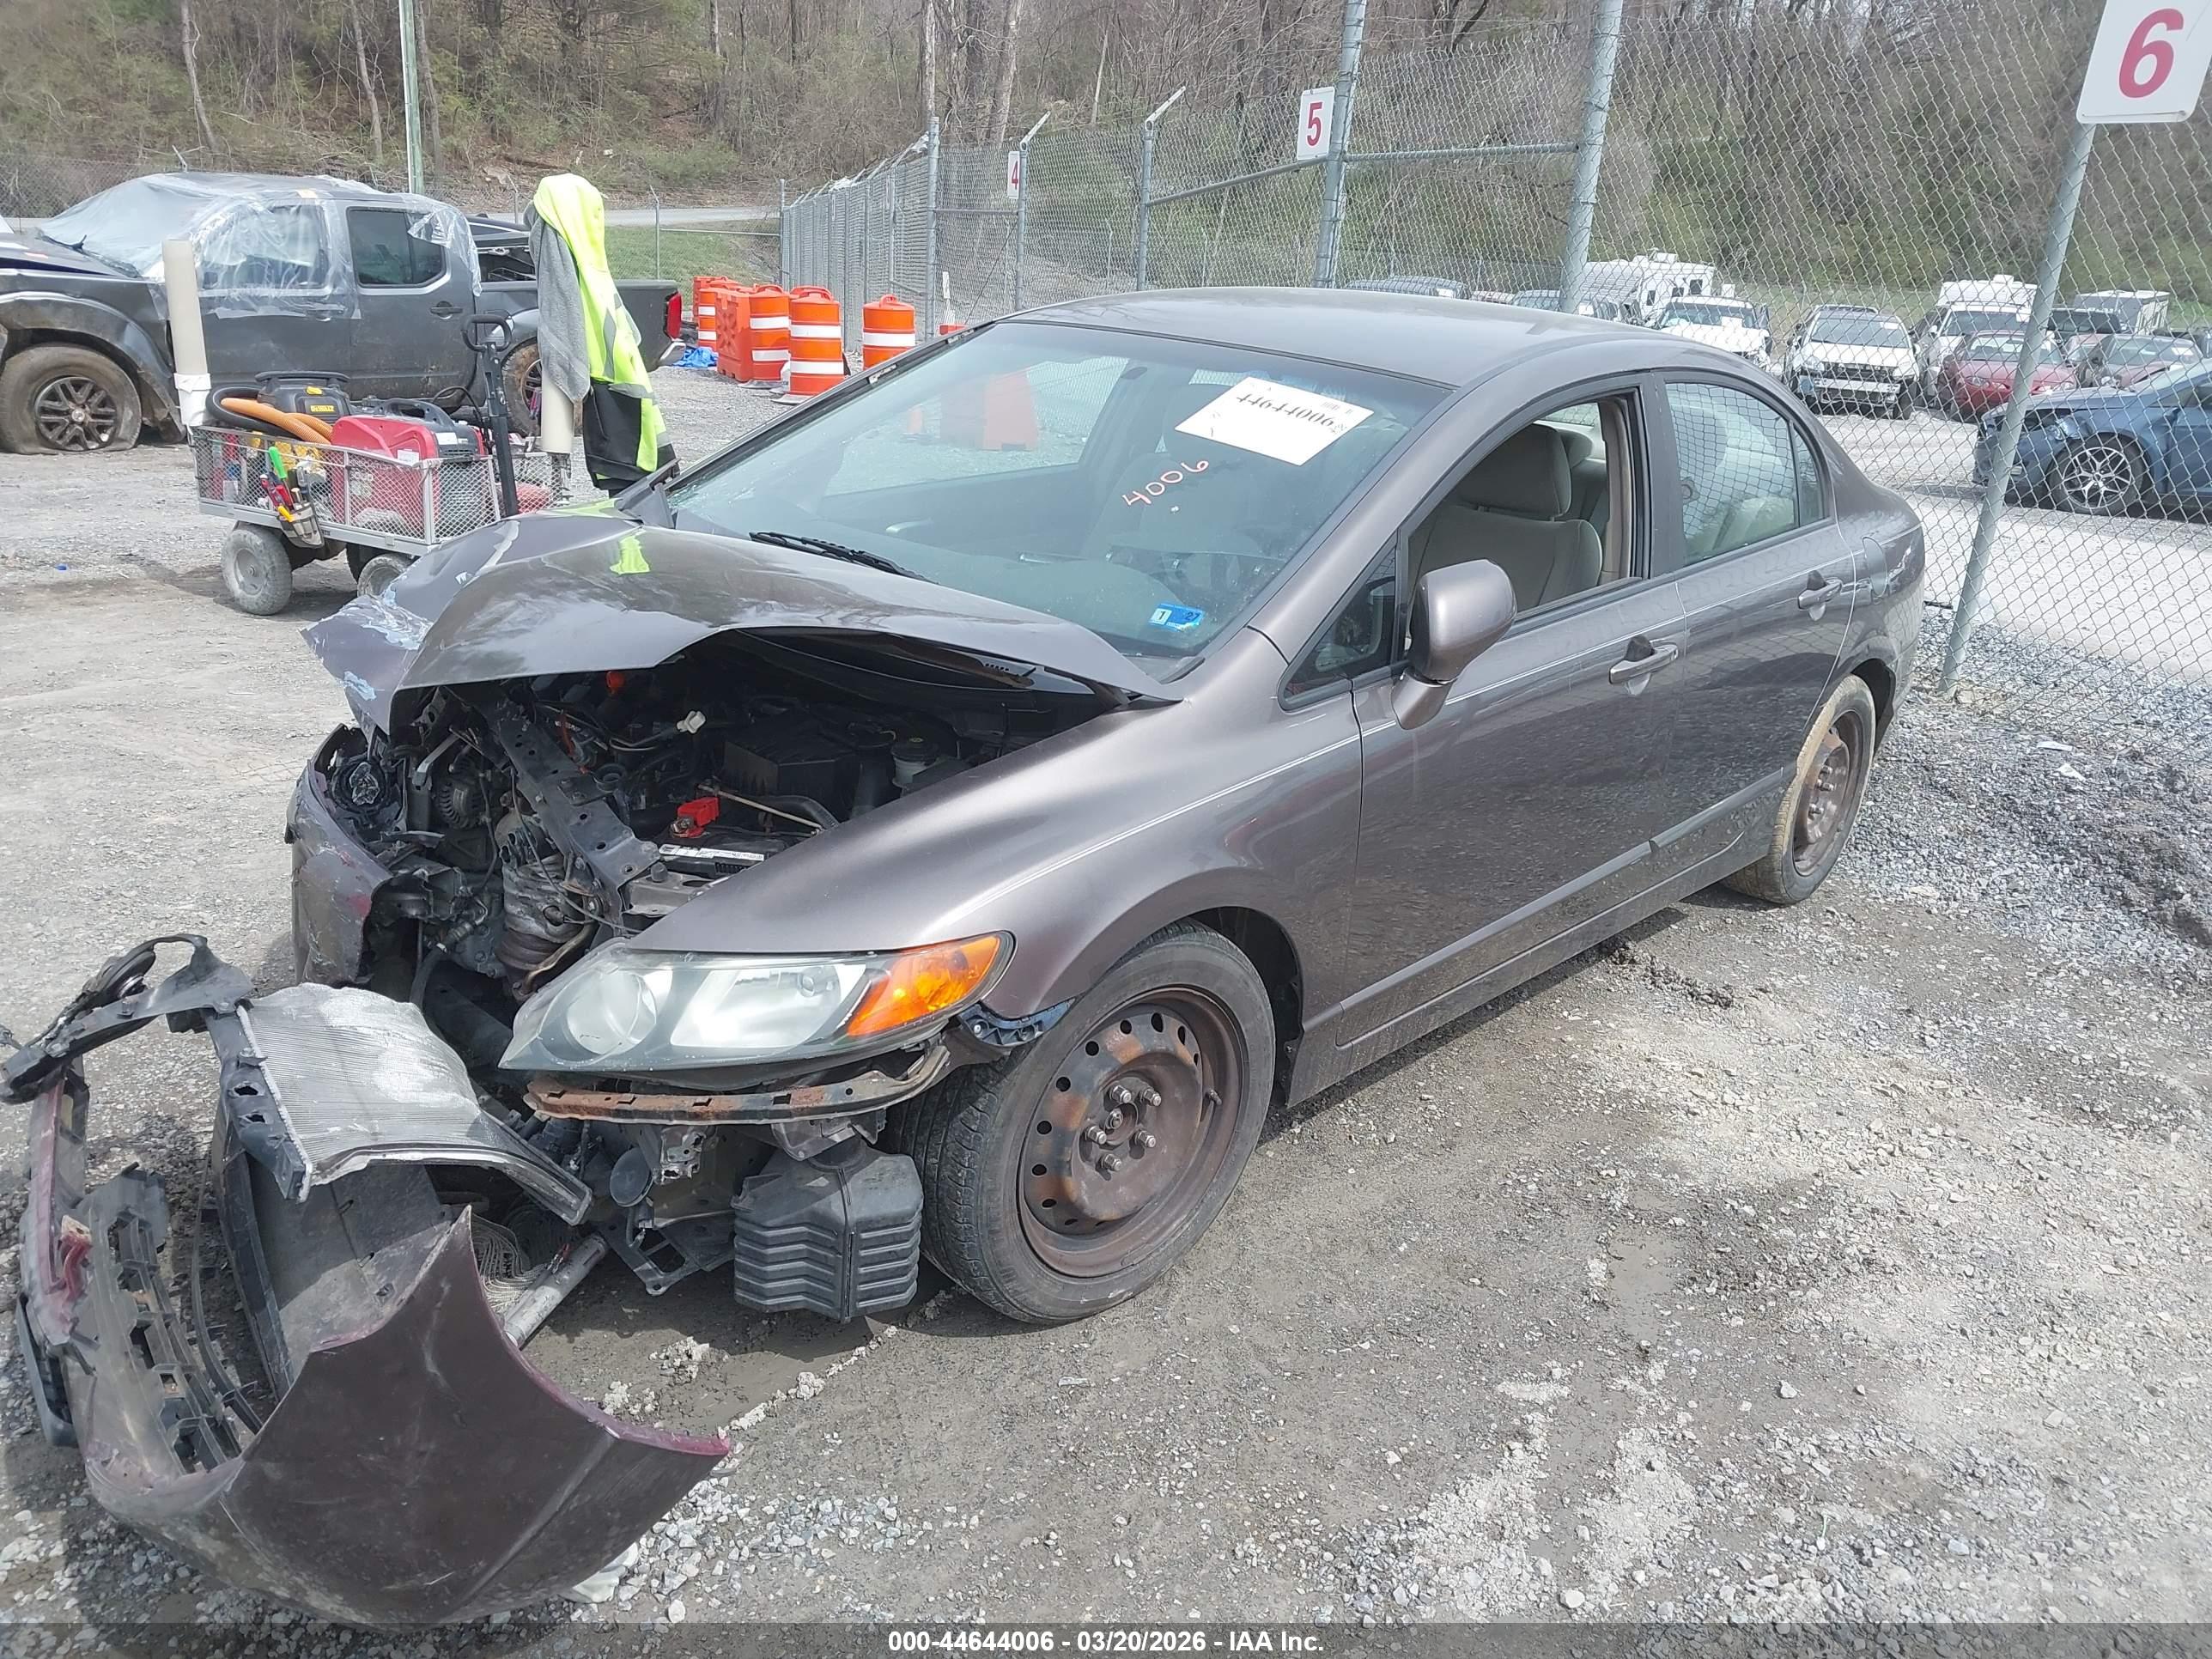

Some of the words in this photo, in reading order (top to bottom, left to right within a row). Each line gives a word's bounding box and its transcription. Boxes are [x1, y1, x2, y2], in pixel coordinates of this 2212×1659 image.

[2119, 8, 2185, 99] 6
[1307, 101, 1323, 147] 5
[1011, 161, 1018, 190] 4
[1237, 393, 1334, 427] 44644006
[1121, 460, 1209, 506] 4006
[1158, 611, 1166, 621] 1
[1185, 611, 1200, 622] 27
